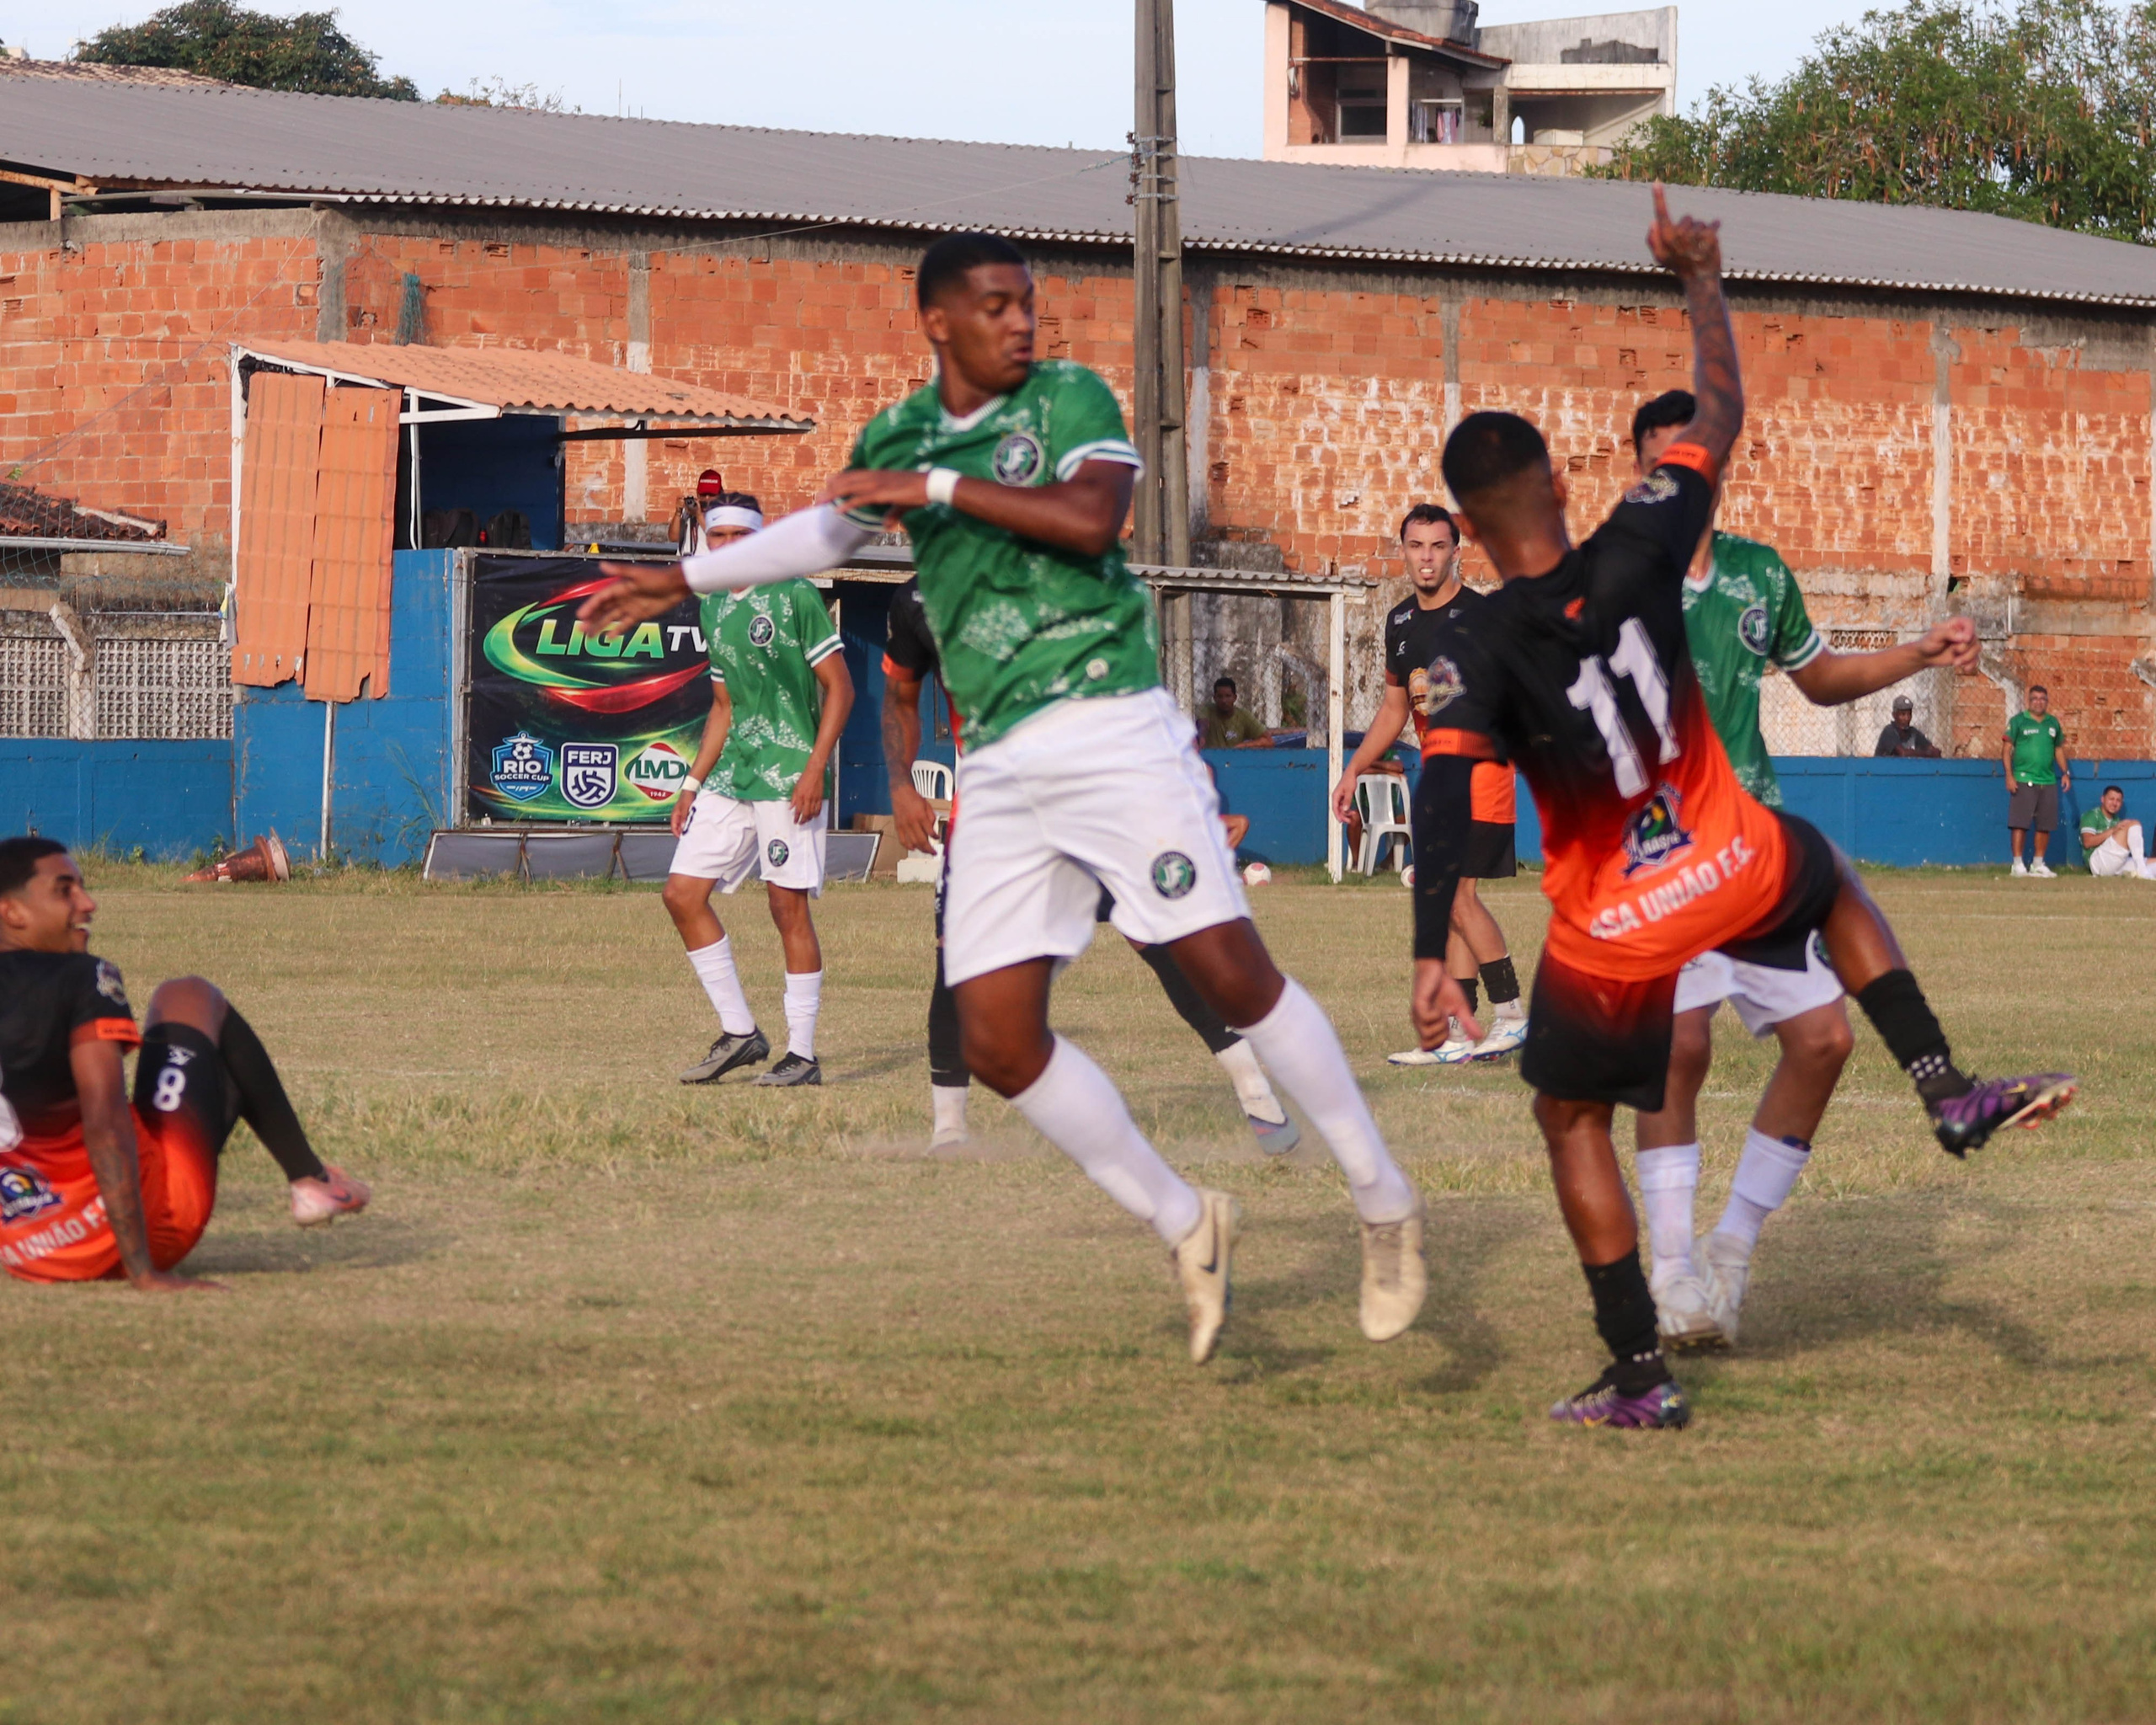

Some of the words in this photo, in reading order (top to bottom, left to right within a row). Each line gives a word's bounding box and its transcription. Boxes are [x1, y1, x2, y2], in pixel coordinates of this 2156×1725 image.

[536, 618, 664, 659] LIGA
[666, 625, 709, 653] TV
[1566, 617, 1681, 799] 11
[503, 760, 542, 774] RIO
[567, 750, 612, 765] FERJ
[634, 759, 686, 780] LMD
[1638, 861, 1720, 922] UNIÃO
[153, 1066, 186, 1112] 8
[16, 1218, 88, 1261] UNIÃO
